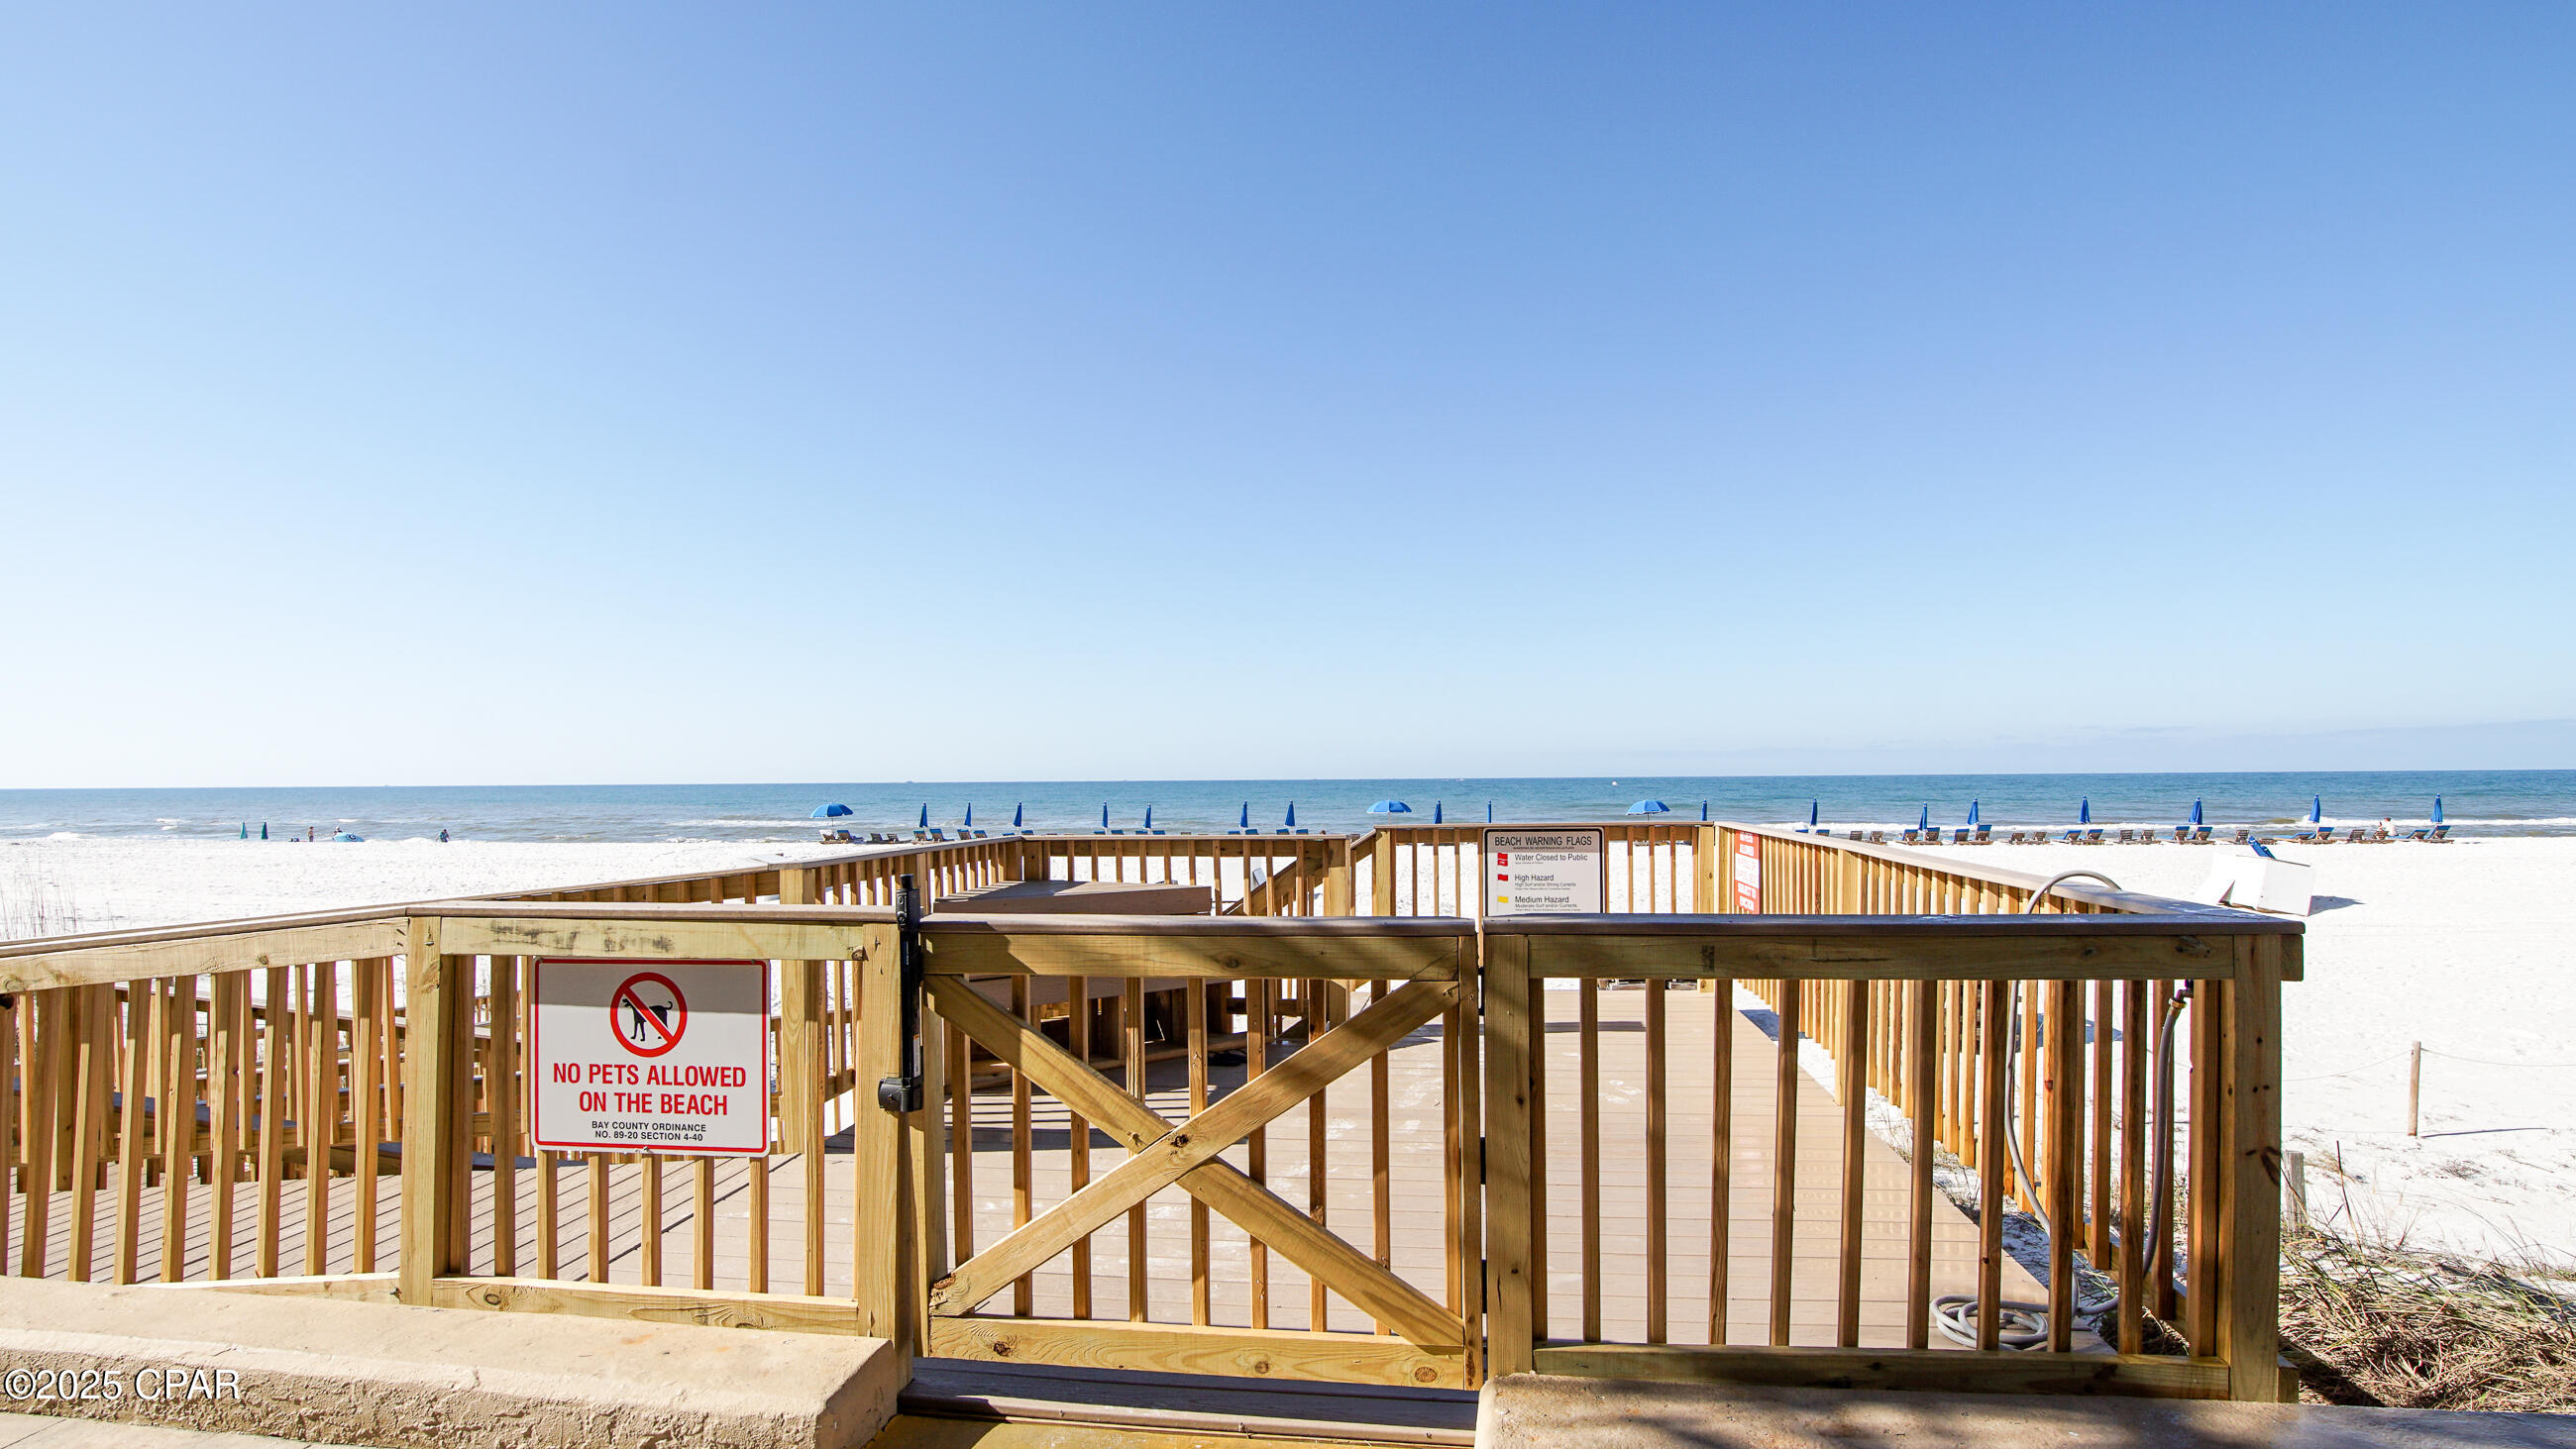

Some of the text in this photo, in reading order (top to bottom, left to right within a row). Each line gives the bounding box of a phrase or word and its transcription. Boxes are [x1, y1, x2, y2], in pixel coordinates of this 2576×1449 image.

[1494, 836, 1592, 846] BEACH WARNING FLAGS
[1514, 874, 1530, 882] High
[553, 1063, 747, 1087] NO PETS ALLOWED
[579, 1091, 728, 1115] ON THE BEACH
[591, 1121, 706, 1132] BAY COUNTY ORDINANCE
[613, 1131, 638, 1140] 89-20
[640, 1132, 681, 1141] SECTION
